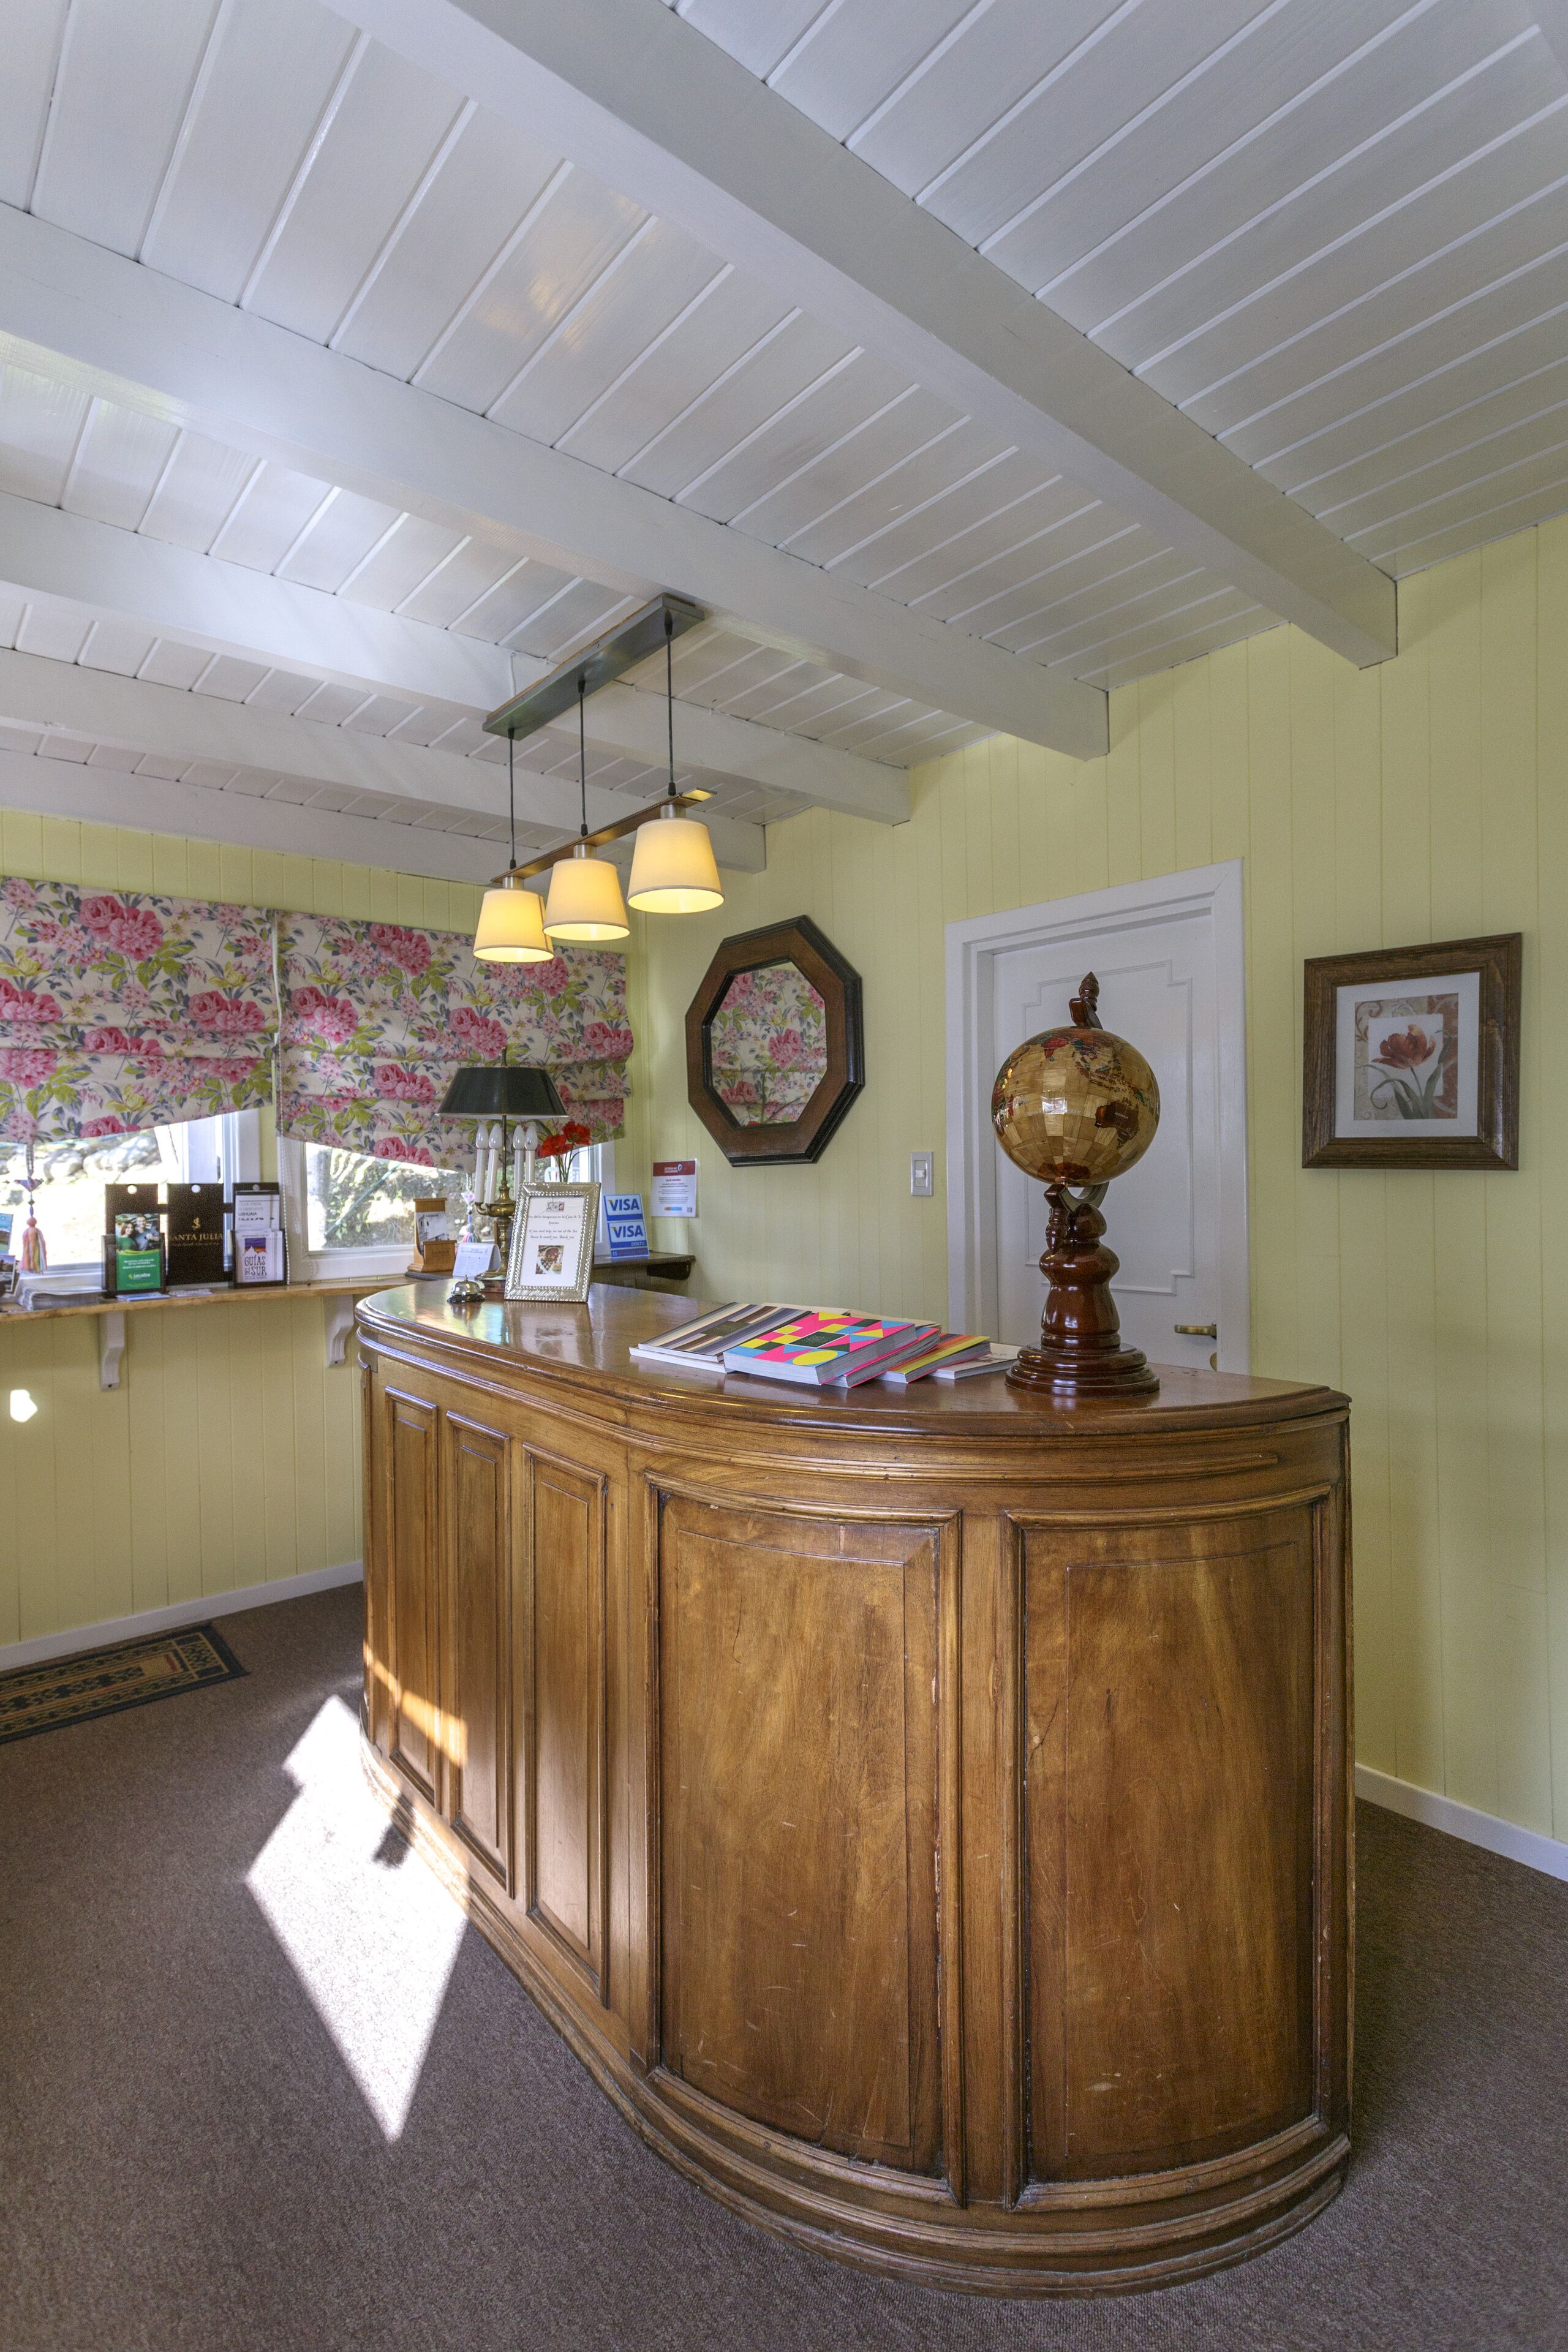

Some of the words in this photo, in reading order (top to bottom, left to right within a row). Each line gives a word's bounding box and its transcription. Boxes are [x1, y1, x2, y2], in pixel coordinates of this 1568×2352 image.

[608, 1199, 639, 1212] VISA
[611, 1225, 644, 1238] VISA
[245, 1254, 266, 1266] GUÍAS
[251, 1266, 267, 1275] SUR
